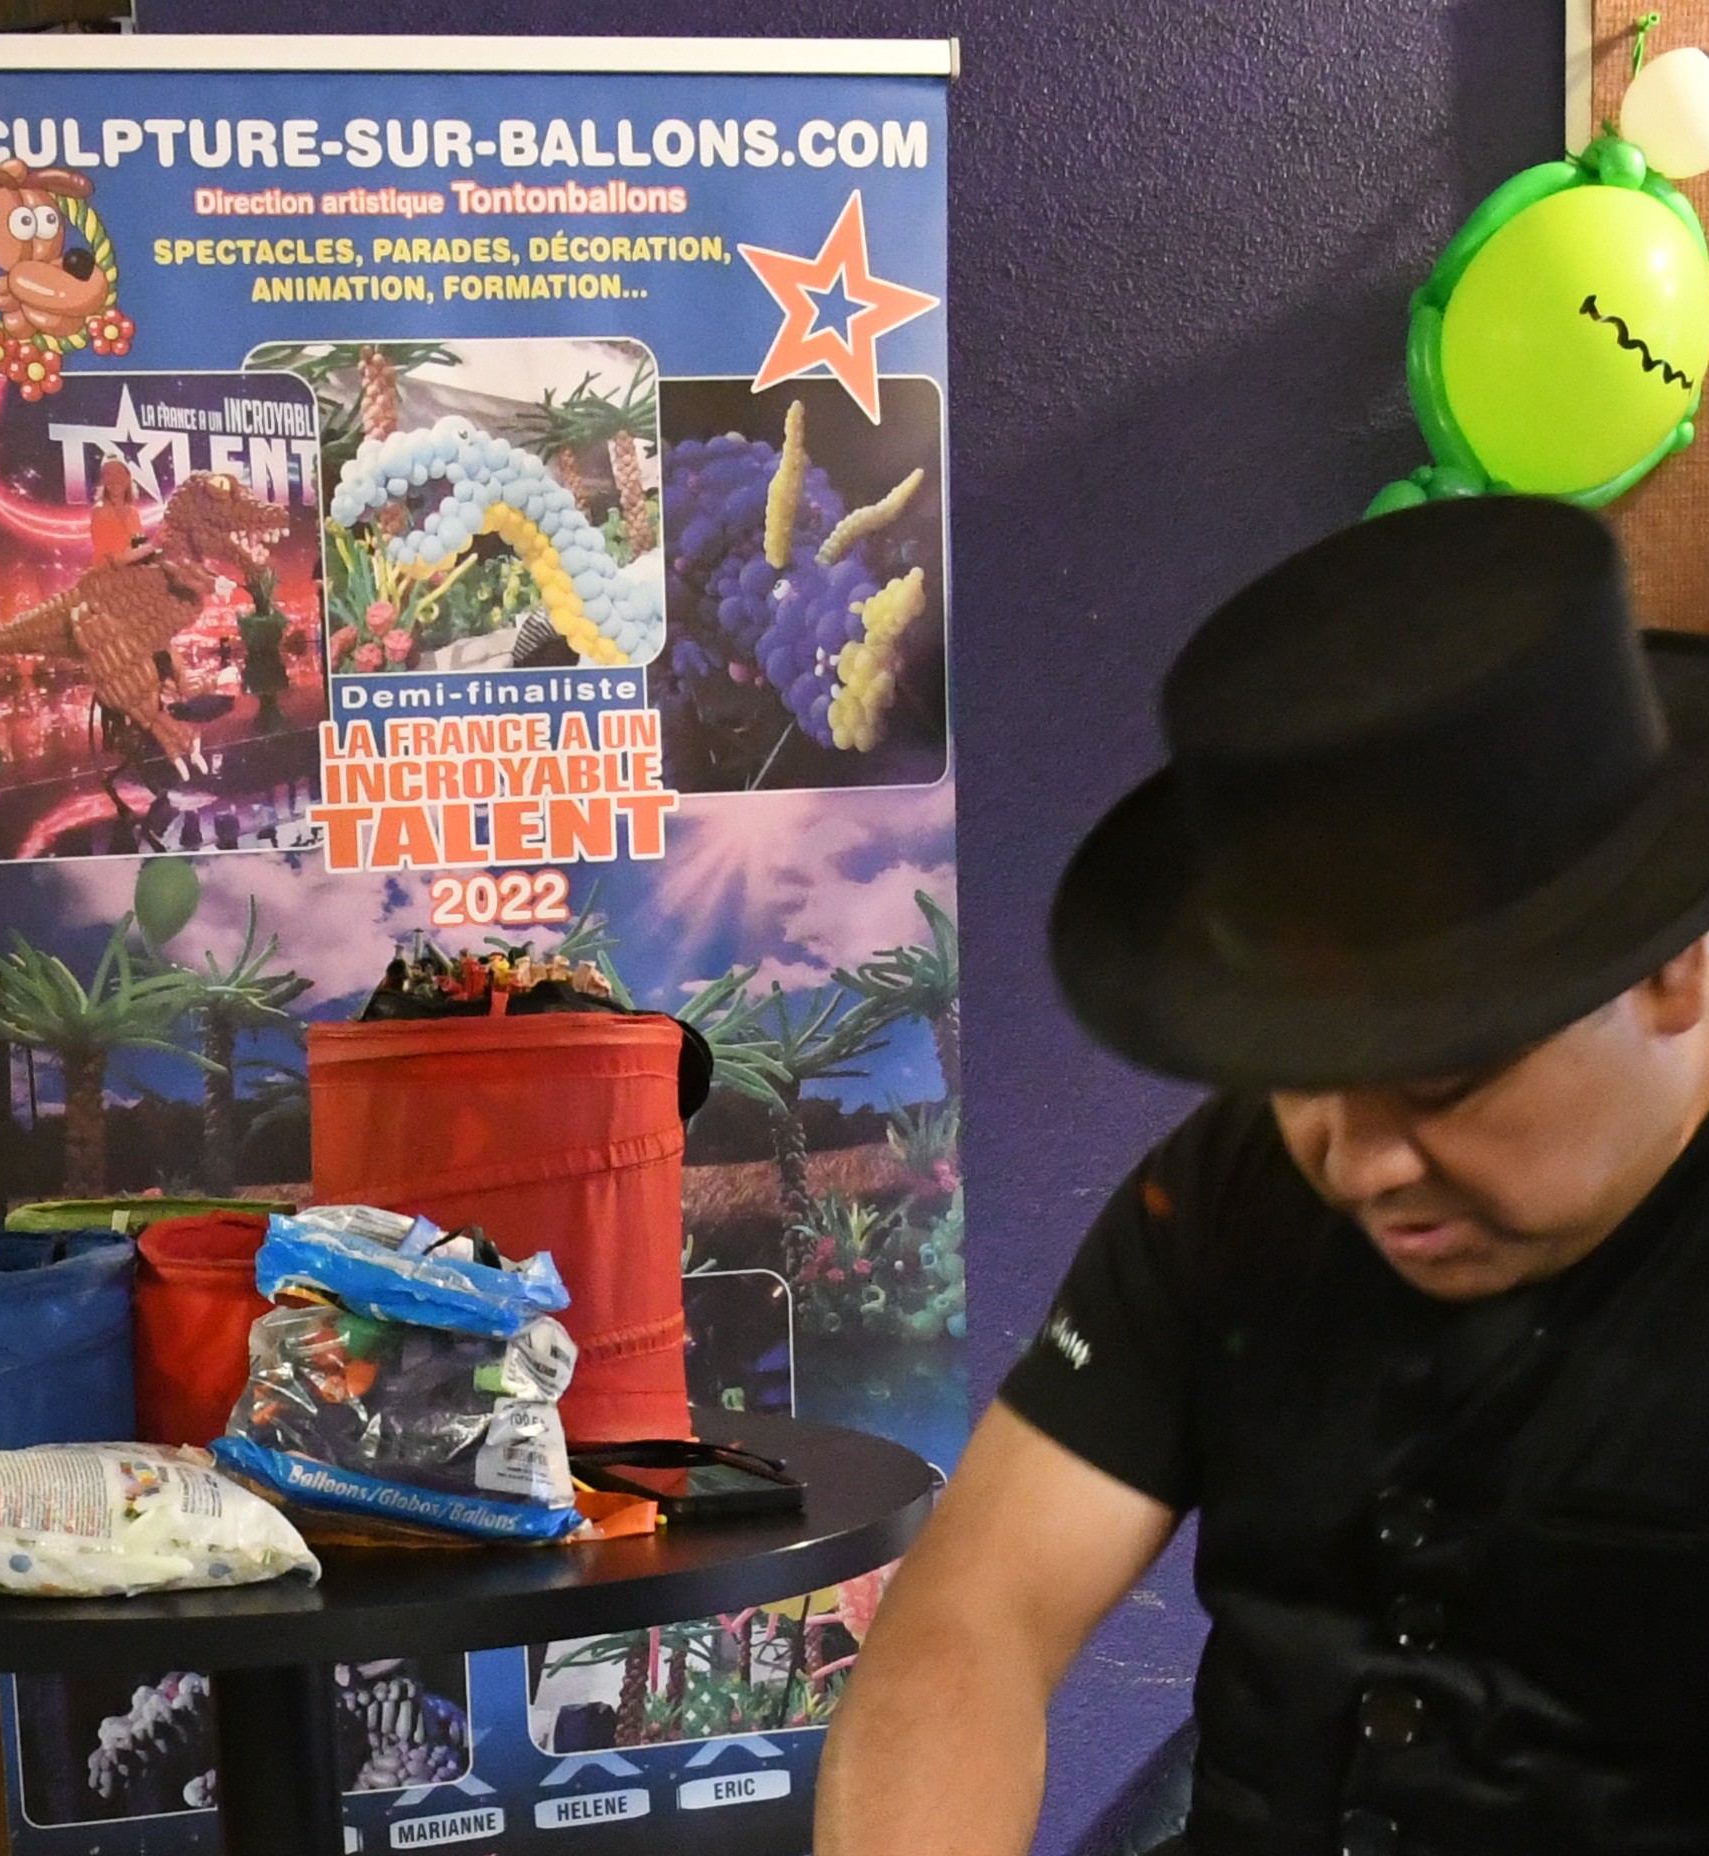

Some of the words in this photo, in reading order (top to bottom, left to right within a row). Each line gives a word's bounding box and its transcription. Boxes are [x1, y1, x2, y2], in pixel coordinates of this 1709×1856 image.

[194, 188, 314, 216] Direction
[320, 189, 444, 218] artistique
[450, 180, 688, 215] Tontonballons
[152, 237, 363, 267] SPECTACLES,
[371, 236, 521, 266] PARADES,
[529, 229, 732, 265] DÉCORATION,
[250, 275, 435, 305] ANIMATION,
[444, 275, 648, 301] FORMATION...
[140, 404, 156, 427] LA
[157, 404, 197, 431] FRANCE
[208, 411, 223, 432] UN
[224, 397, 318, 437] INCROYABL
[341, 678, 637, 709] Demi-finaliste
[324, 724, 375, 760] LA
[390, 718, 547, 757] FRANCE
[561, 717, 587, 751] A
[603, 714, 657, 749] UN
[324, 752, 659, 805] INCROYABLE
[311, 795, 675, 869] TALENT
[431, 875, 568, 925] 2022
[713, 1777, 757, 1801] ERIC
[556, 1796, 629, 1823] HELENE
[398, 1814, 497, 1844] MARIANNE
